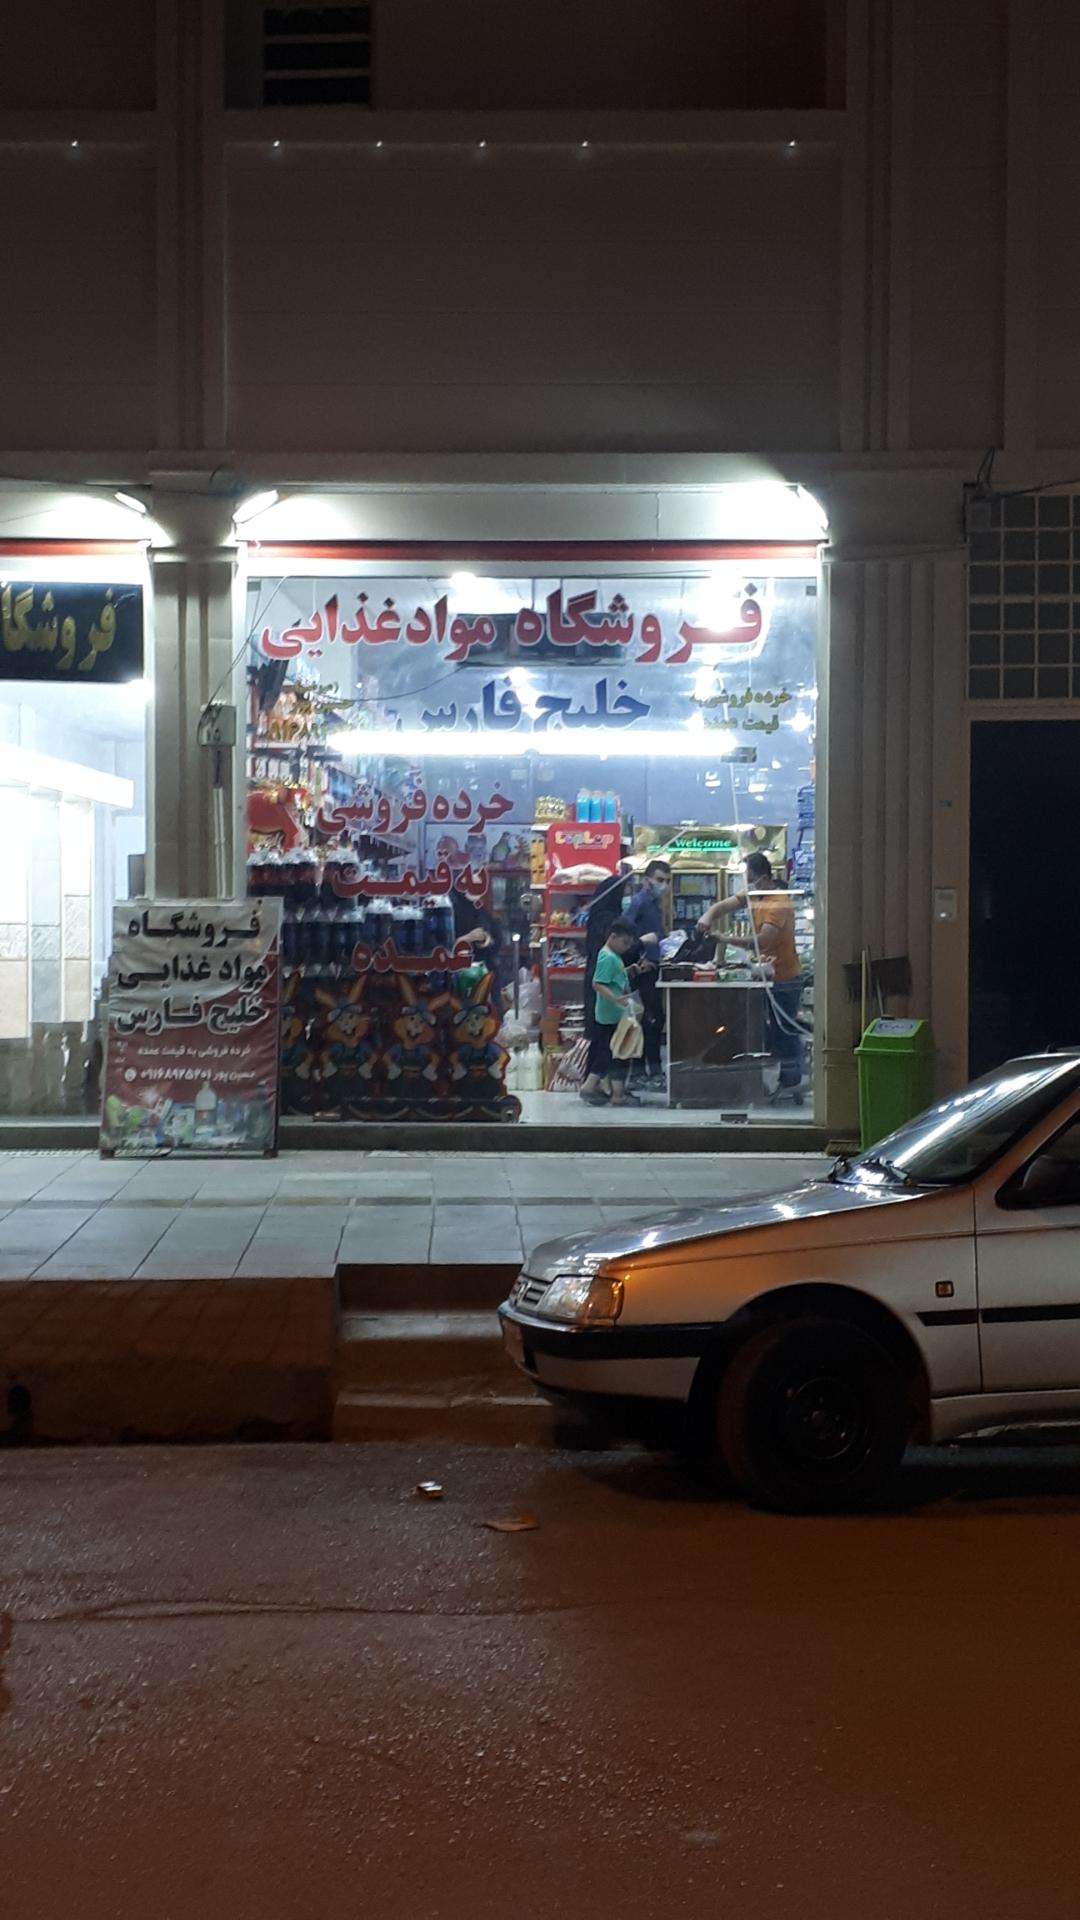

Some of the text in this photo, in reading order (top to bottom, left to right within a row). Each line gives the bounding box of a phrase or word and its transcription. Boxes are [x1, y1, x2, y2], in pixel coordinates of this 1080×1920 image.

[515, 582, 763, 665] فروشگاه
[317, 776, 515, 835] خرده فروشی
[675, 838, 732, 849] Welcome
[332, 849, 489, 909] به قیمت
[127, 899, 263, 948] فروشگاه
[117, 953, 269, 992] مواد غذایی
[351, 936, 475, 973] عمده
[116, 995, 269, 1034] خلیج فارس
